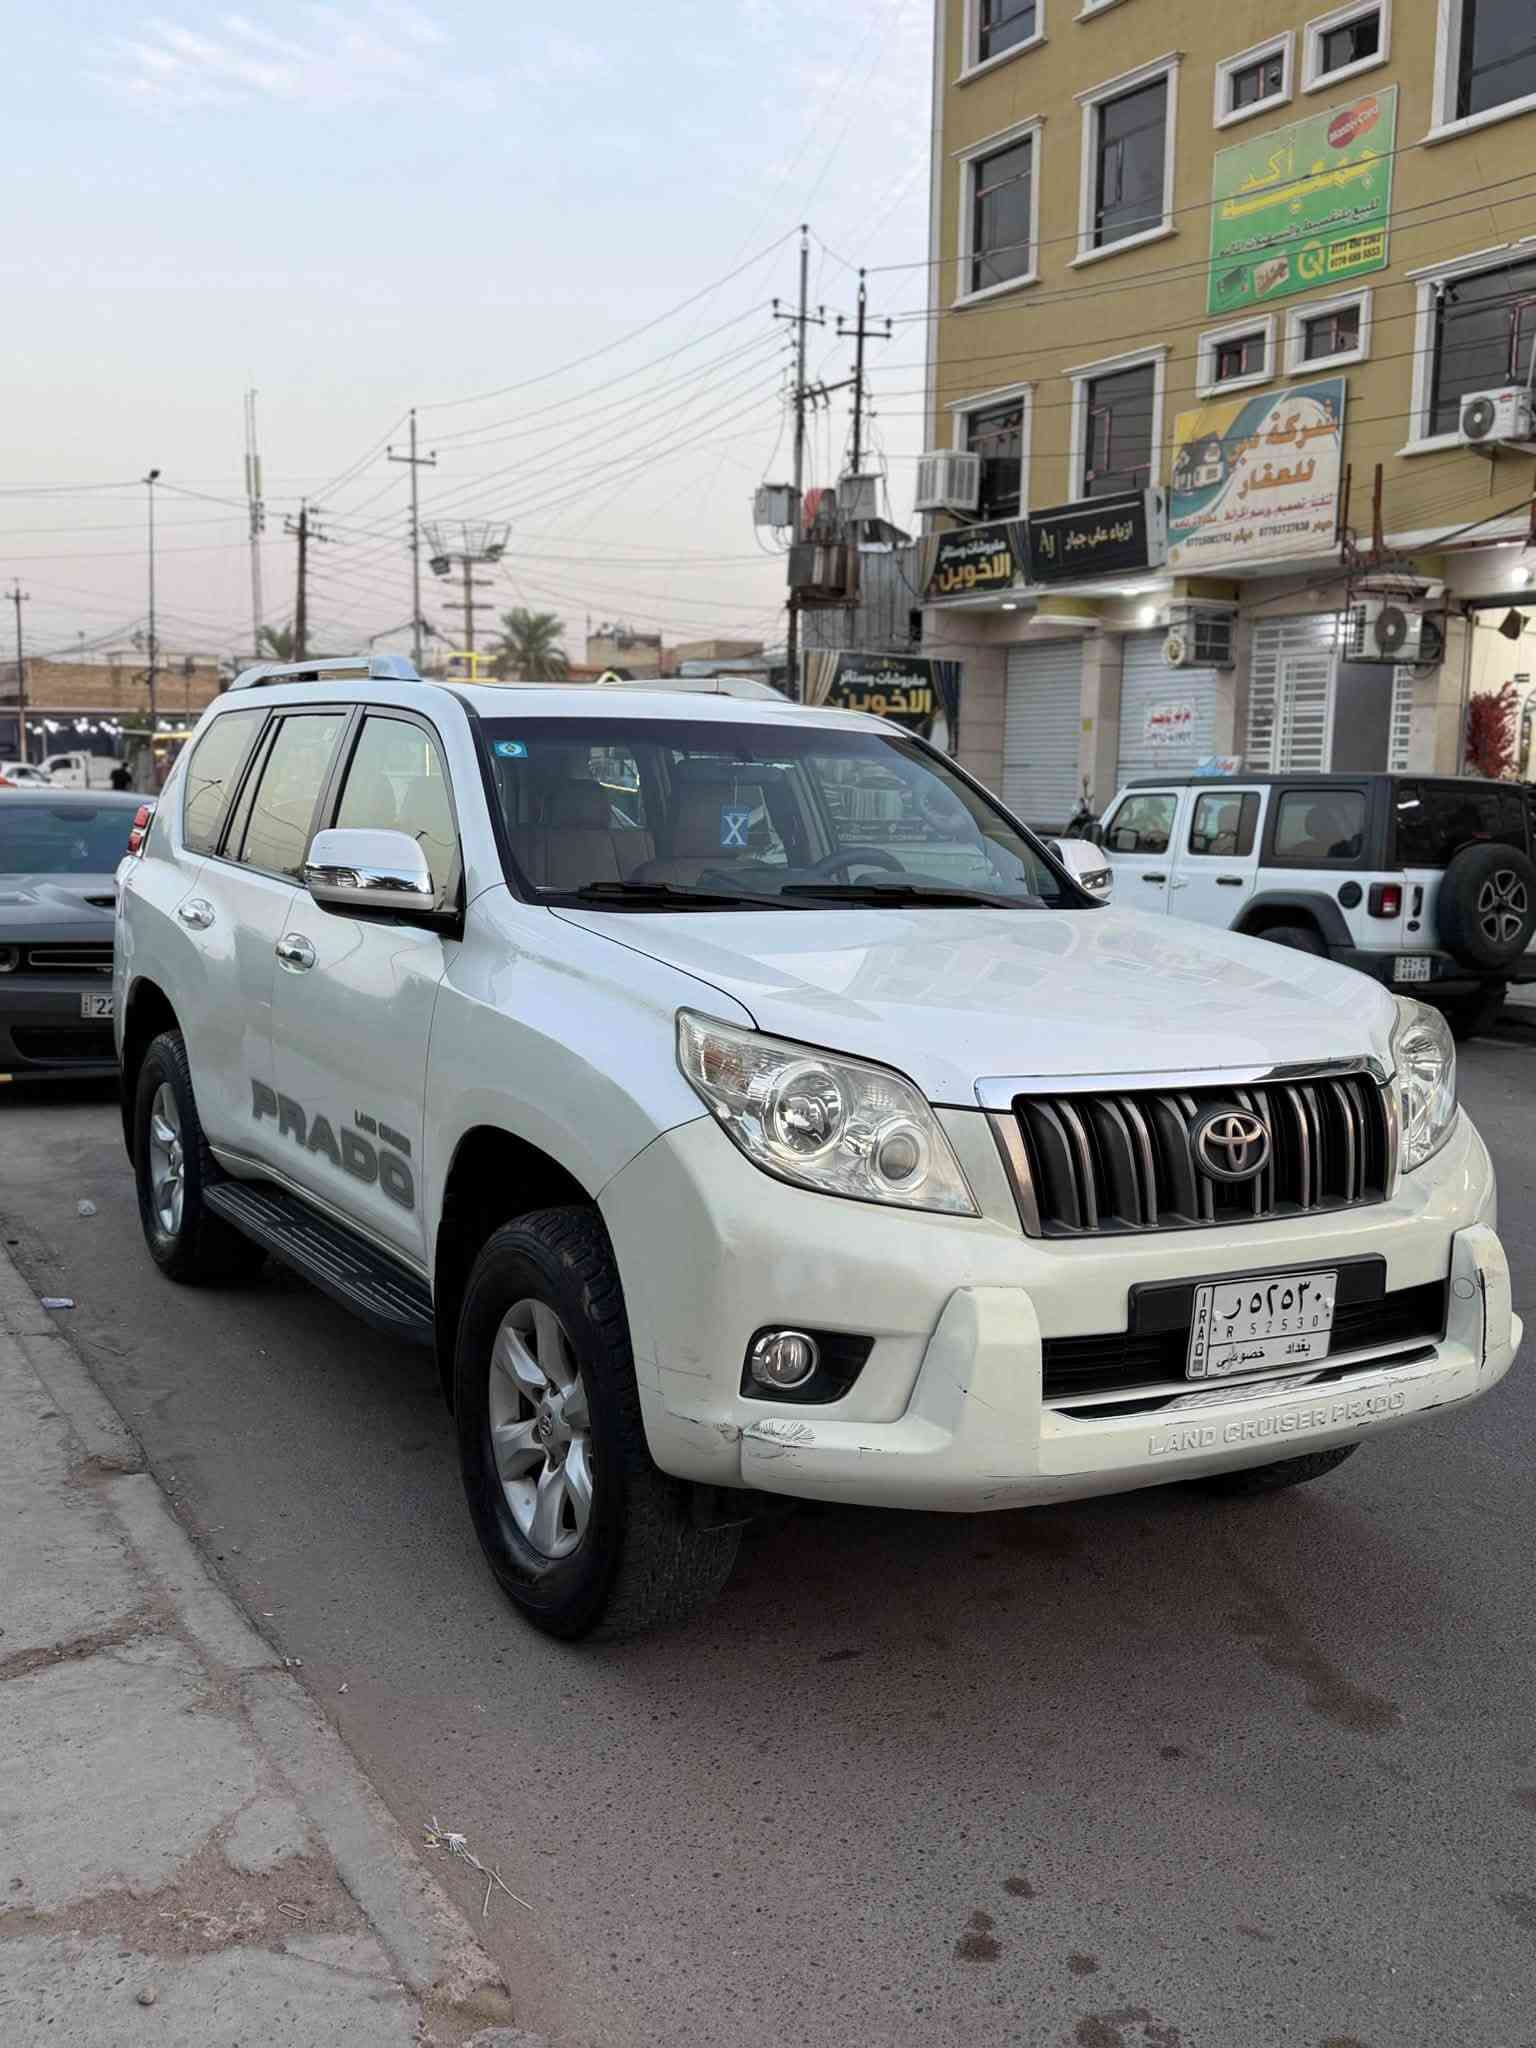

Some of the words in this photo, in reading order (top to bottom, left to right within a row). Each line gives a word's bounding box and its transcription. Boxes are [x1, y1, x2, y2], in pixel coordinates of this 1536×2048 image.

[938, 551, 1011, 591] الاخوين
[250, 1077, 416, 1209] PRADO
[1226, 1325, 1234, 1338] R
[1249, 1314, 1319, 1335] 52530
[1285, 1338, 1311, 1356] بغداد
[1147, 1425, 1216, 1456] LAND
[1223, 1408, 1326, 1444] CRUISER
[1330, 1391, 1406, 1423] PRADO
